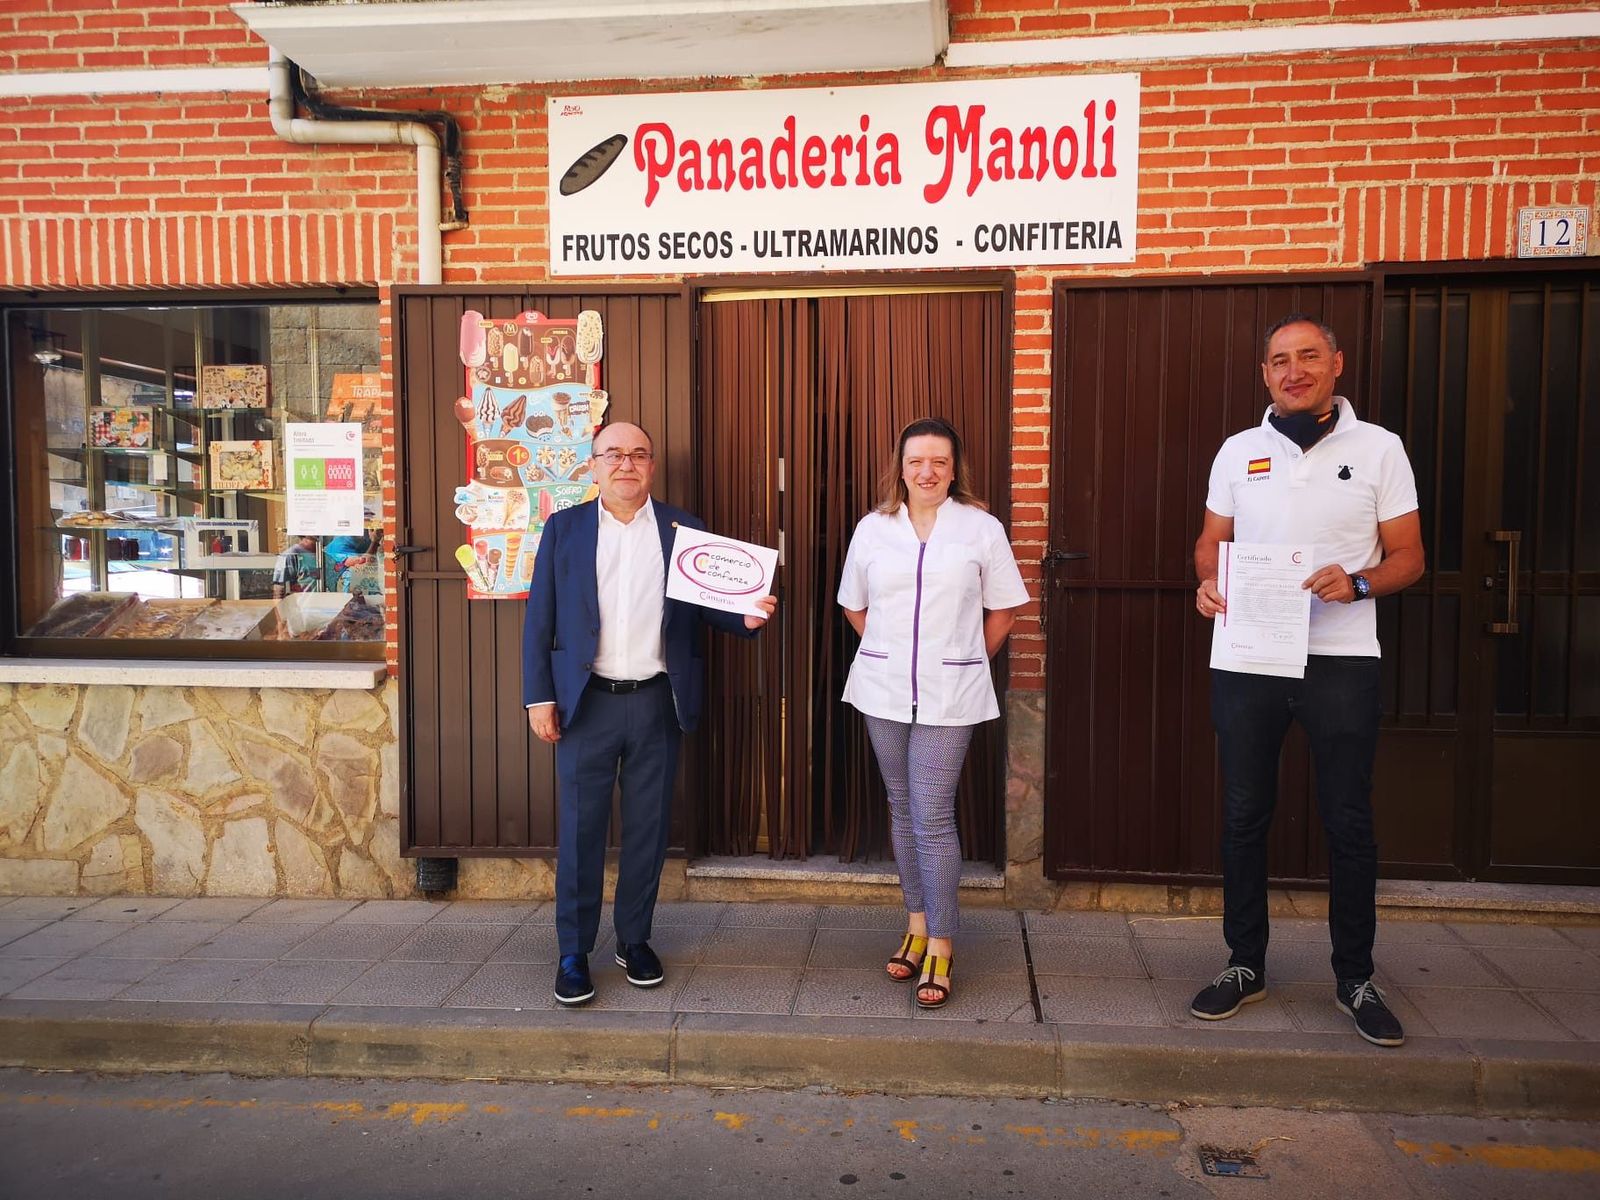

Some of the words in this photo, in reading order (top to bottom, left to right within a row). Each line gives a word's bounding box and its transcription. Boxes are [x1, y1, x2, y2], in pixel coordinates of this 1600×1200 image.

[633, 114, 902, 208] Panaderia
[923, 99, 1117, 205] Manoli
[562, 232, 650, 262] FRUTOS
[658, 231, 733, 260] SECOS
[753, 226, 939, 258] ULTRAMARINOS
[974, 220, 1122, 253] CONFITERIA
[1539, 218, 1570, 246] 12
